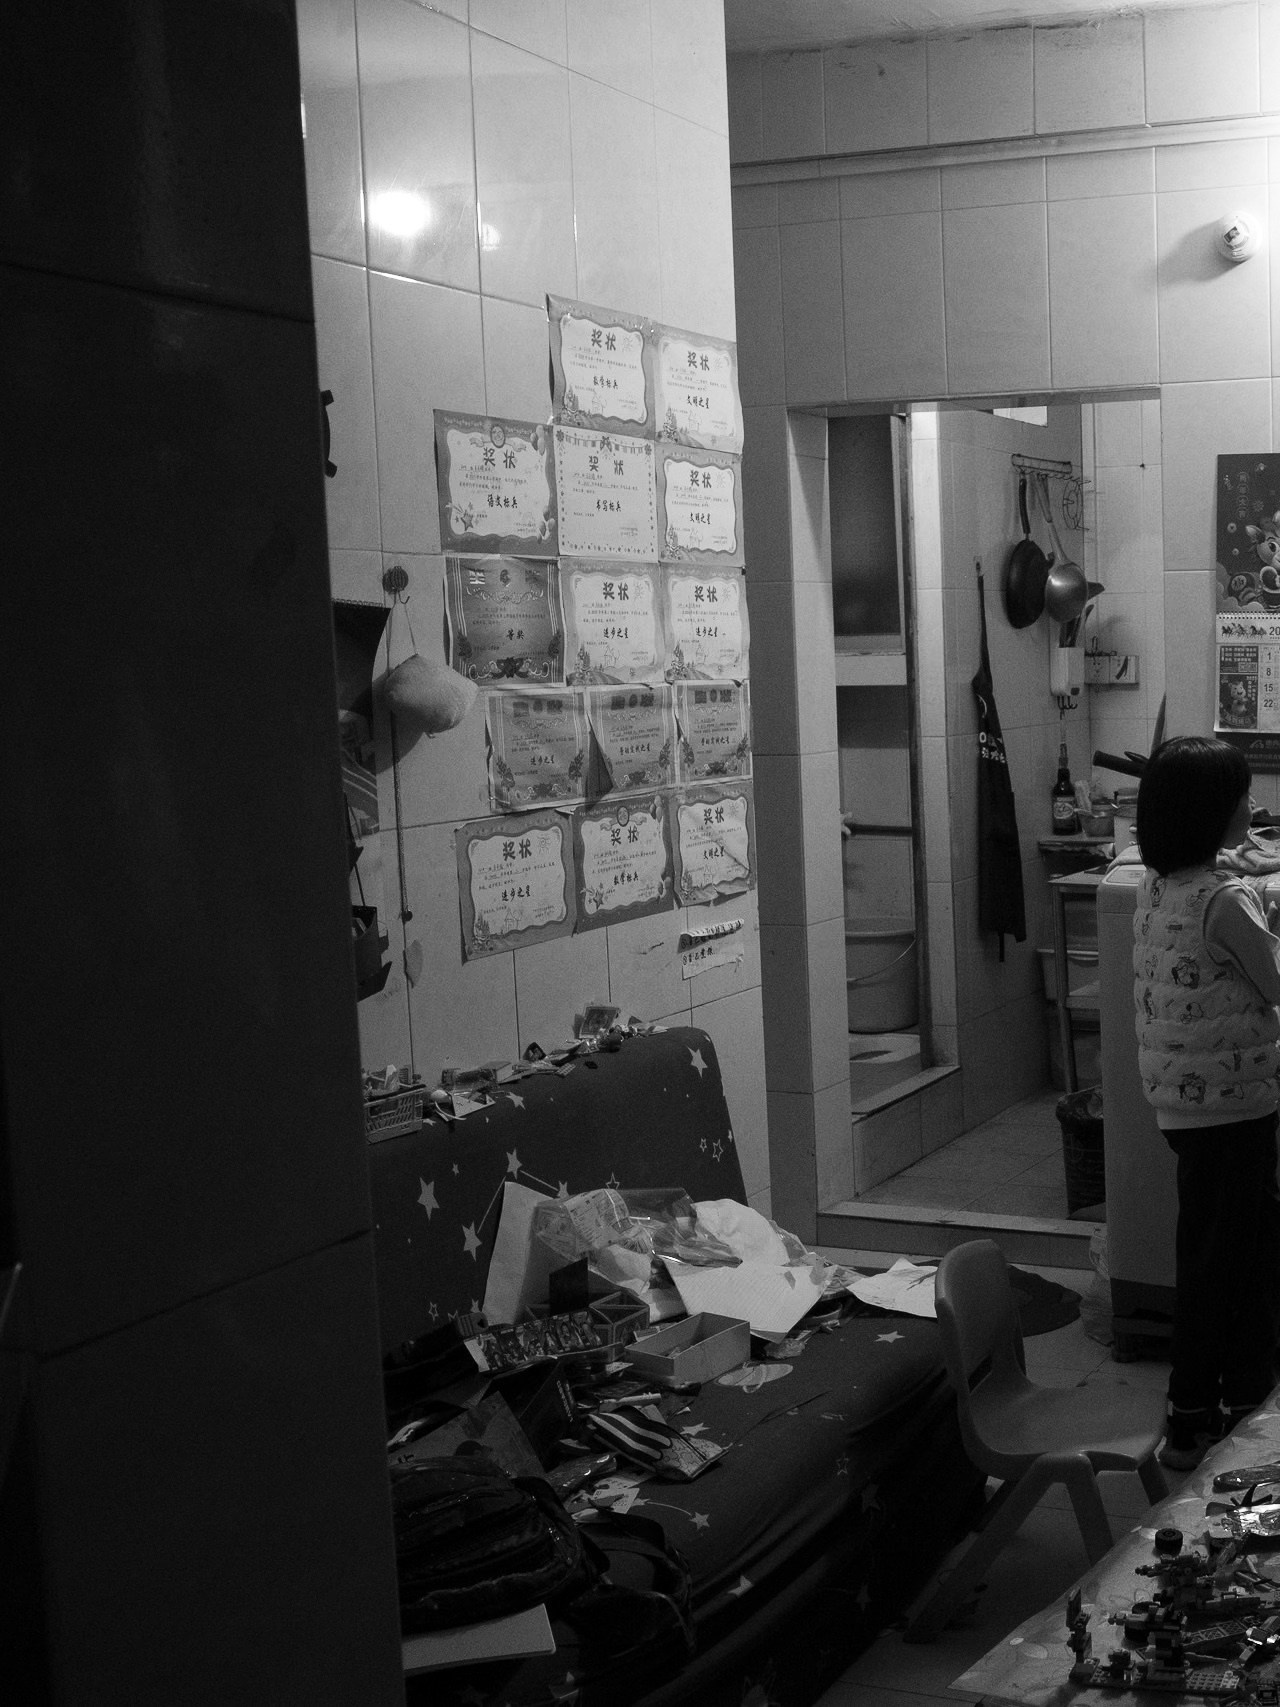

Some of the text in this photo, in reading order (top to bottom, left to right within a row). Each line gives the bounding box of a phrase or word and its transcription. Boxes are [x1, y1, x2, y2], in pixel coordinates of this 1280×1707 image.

[591, 328, 616, 351] 奖状
[687, 350, 710, 371] 奖状
[687, 394, 710, 409] 文明之星
[483, 447, 516, 469] 奖状
[588, 455, 624, 476] 奖状
[690, 469, 712, 489] 奖状
[487, 493, 518, 508] 语文标兵
[690, 512, 711, 525] 文明之星
[603, 581, 630, 601] 奖状
[695, 585, 718, 603] 奖状
[604, 625, 629, 639] 进步之星
[695, 626, 718, 638] 进步之星
[1266, 667, 1272, 676] 8
[1264, 683, 1274, 692] 15
[1264, 699, 1274, 708] 22
[530, 755, 554, 766] 进步之星
[704, 807, 725, 825] 奖状
[611, 826, 639, 847] 奖状
[503, 839, 533, 862] 奖状
[502, 885, 532, 902] 进步之星
